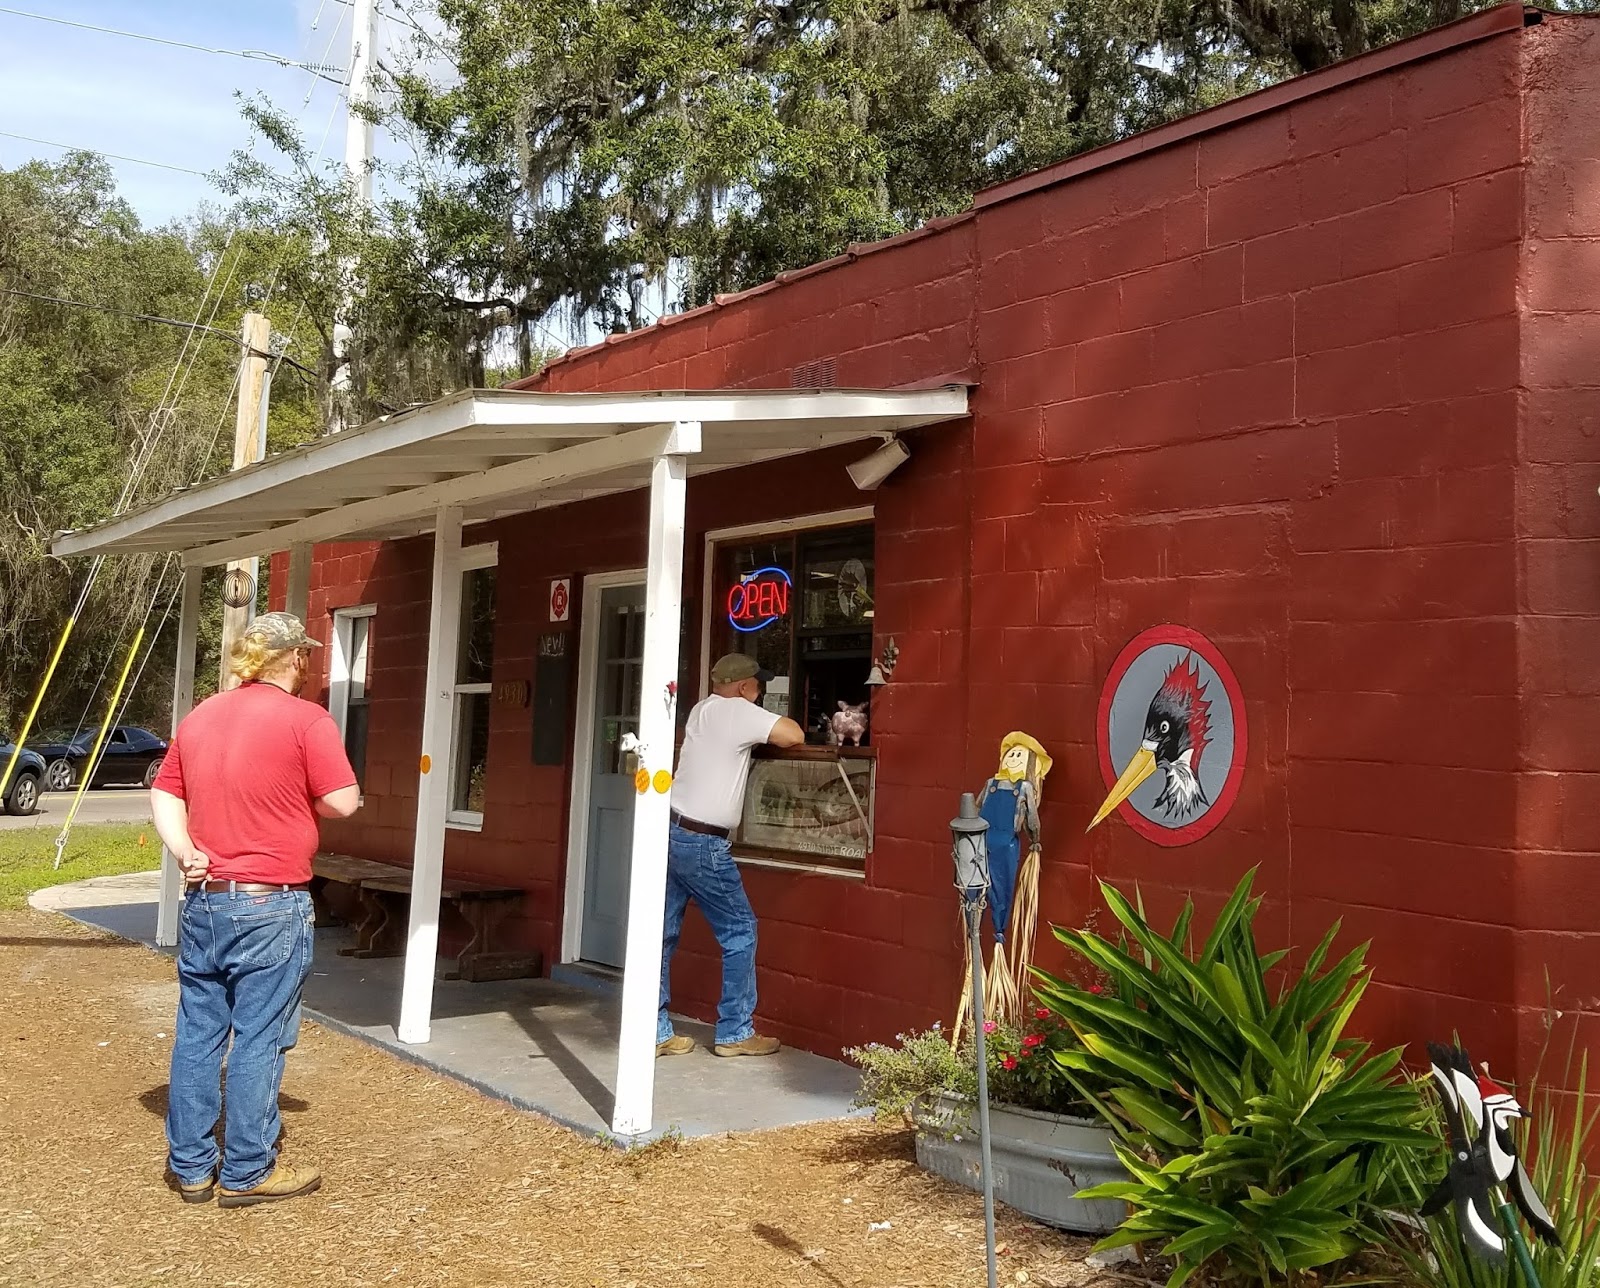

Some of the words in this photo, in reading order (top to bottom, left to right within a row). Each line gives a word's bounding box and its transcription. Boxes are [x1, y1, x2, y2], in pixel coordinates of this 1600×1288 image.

[557, 595, 563, 606] R
[728, 581, 788, 618] OPEN
[817, 844, 840, 855] STATE
